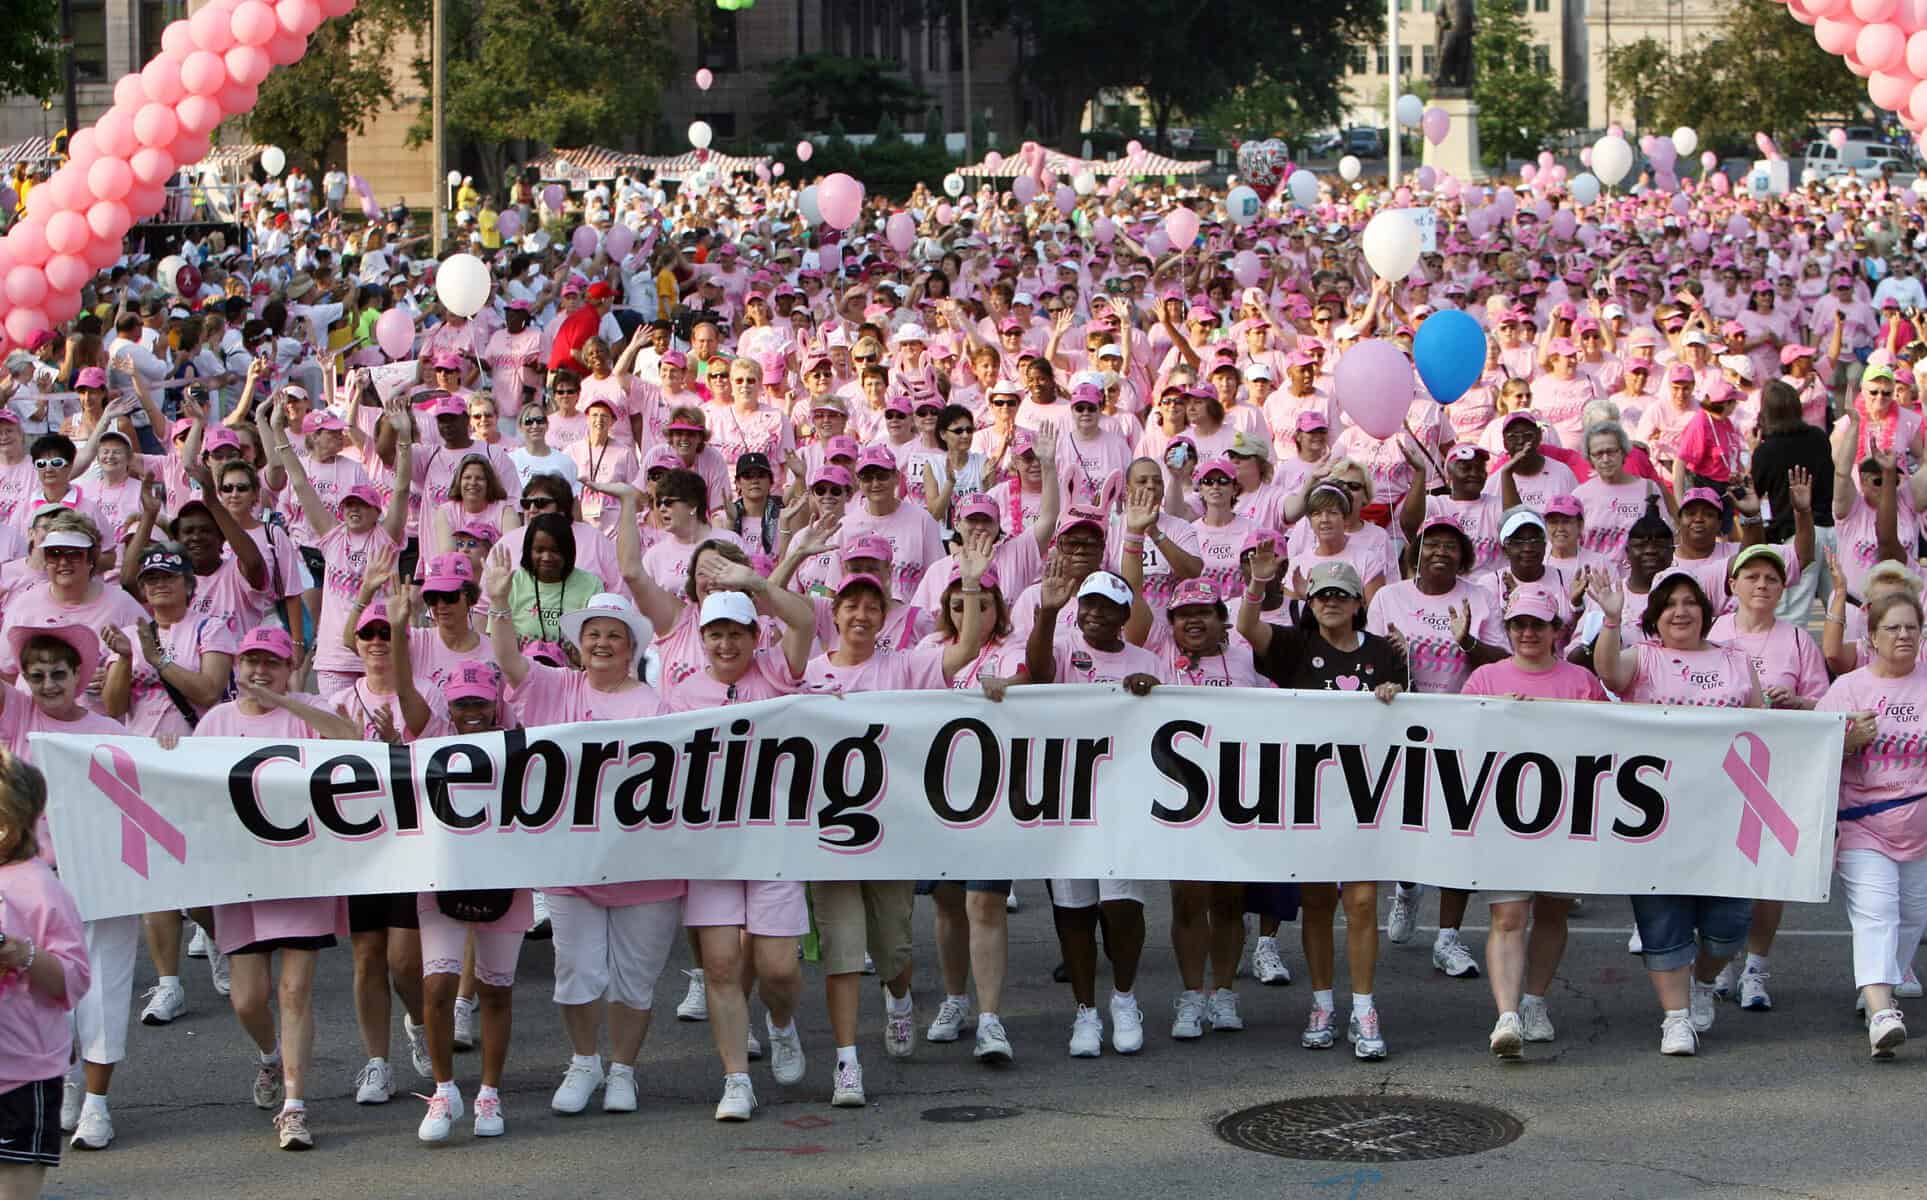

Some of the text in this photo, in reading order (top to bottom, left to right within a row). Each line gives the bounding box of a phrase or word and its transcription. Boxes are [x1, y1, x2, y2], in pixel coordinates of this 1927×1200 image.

[1690, 673, 1719, 683] race
[1885, 705, 1914, 716] race
[227, 716, 1672, 853] Celebrating Our Survivors
